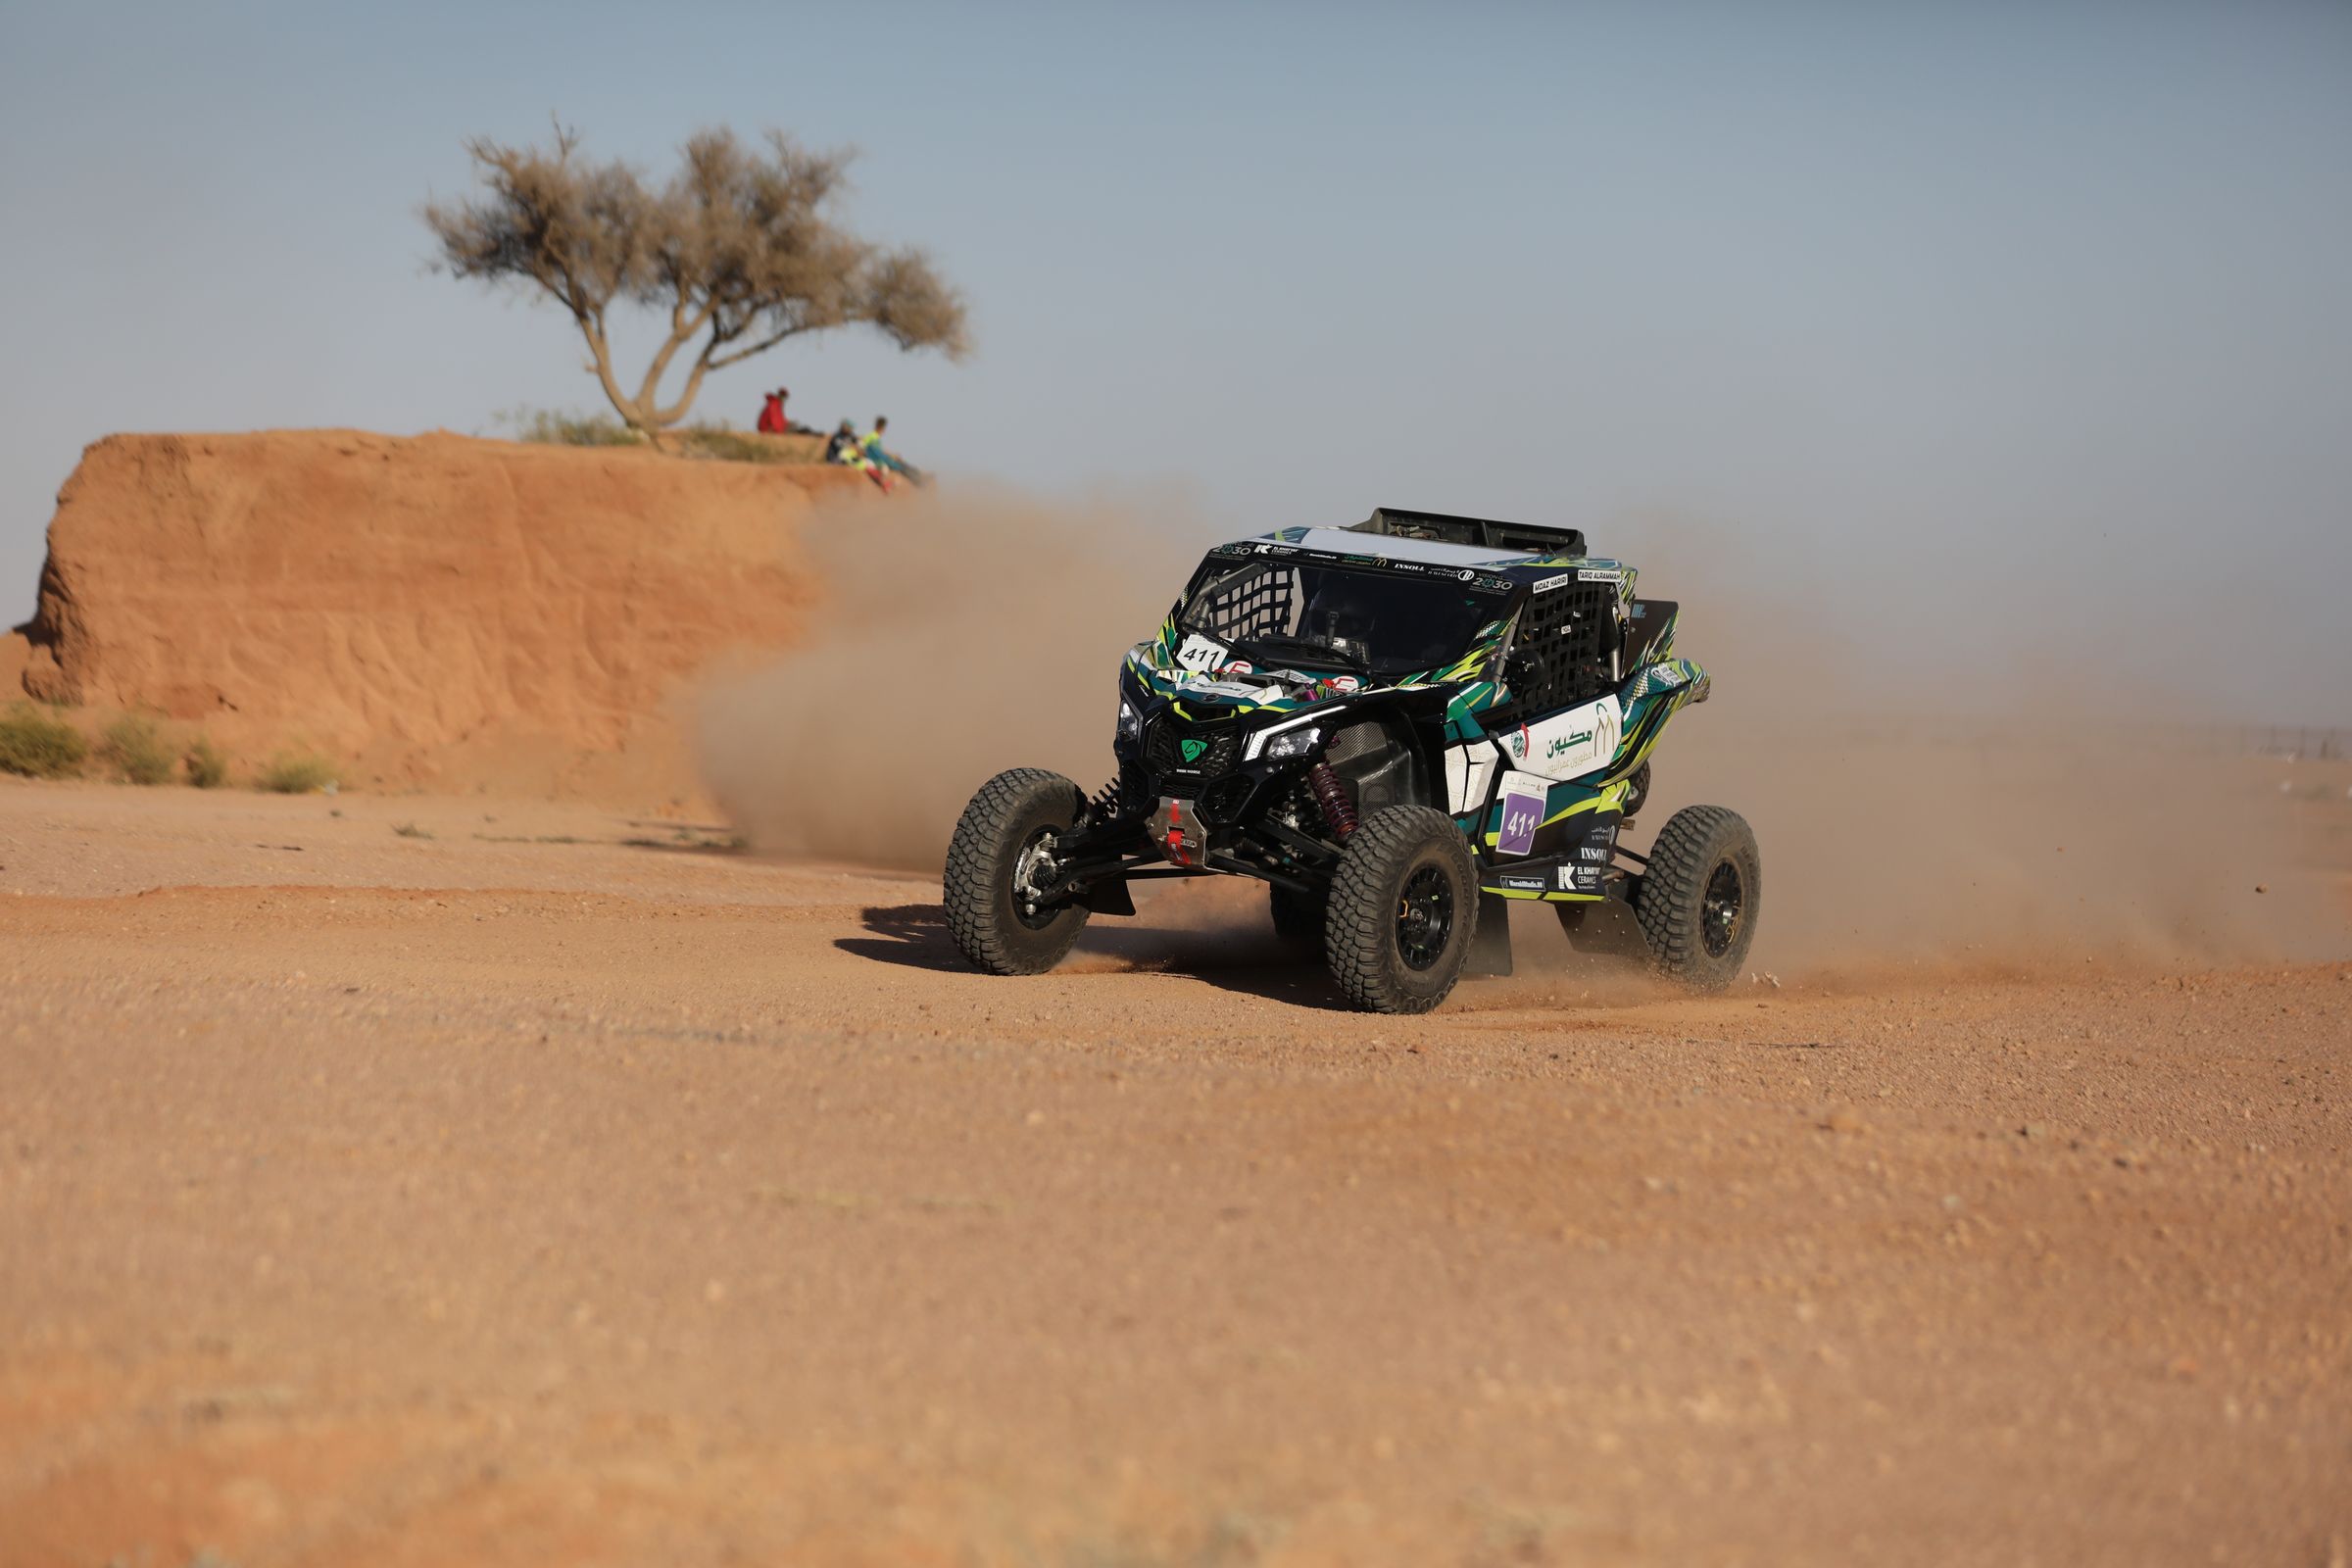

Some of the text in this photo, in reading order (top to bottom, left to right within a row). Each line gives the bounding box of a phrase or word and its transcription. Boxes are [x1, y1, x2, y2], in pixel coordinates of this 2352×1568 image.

[1549, 576, 1567, 588] HARIRI
[1184, 648, 1220, 664] 411
[1546, 729, 1592, 759] مكيون
[1507, 811, 1535, 837] 411
